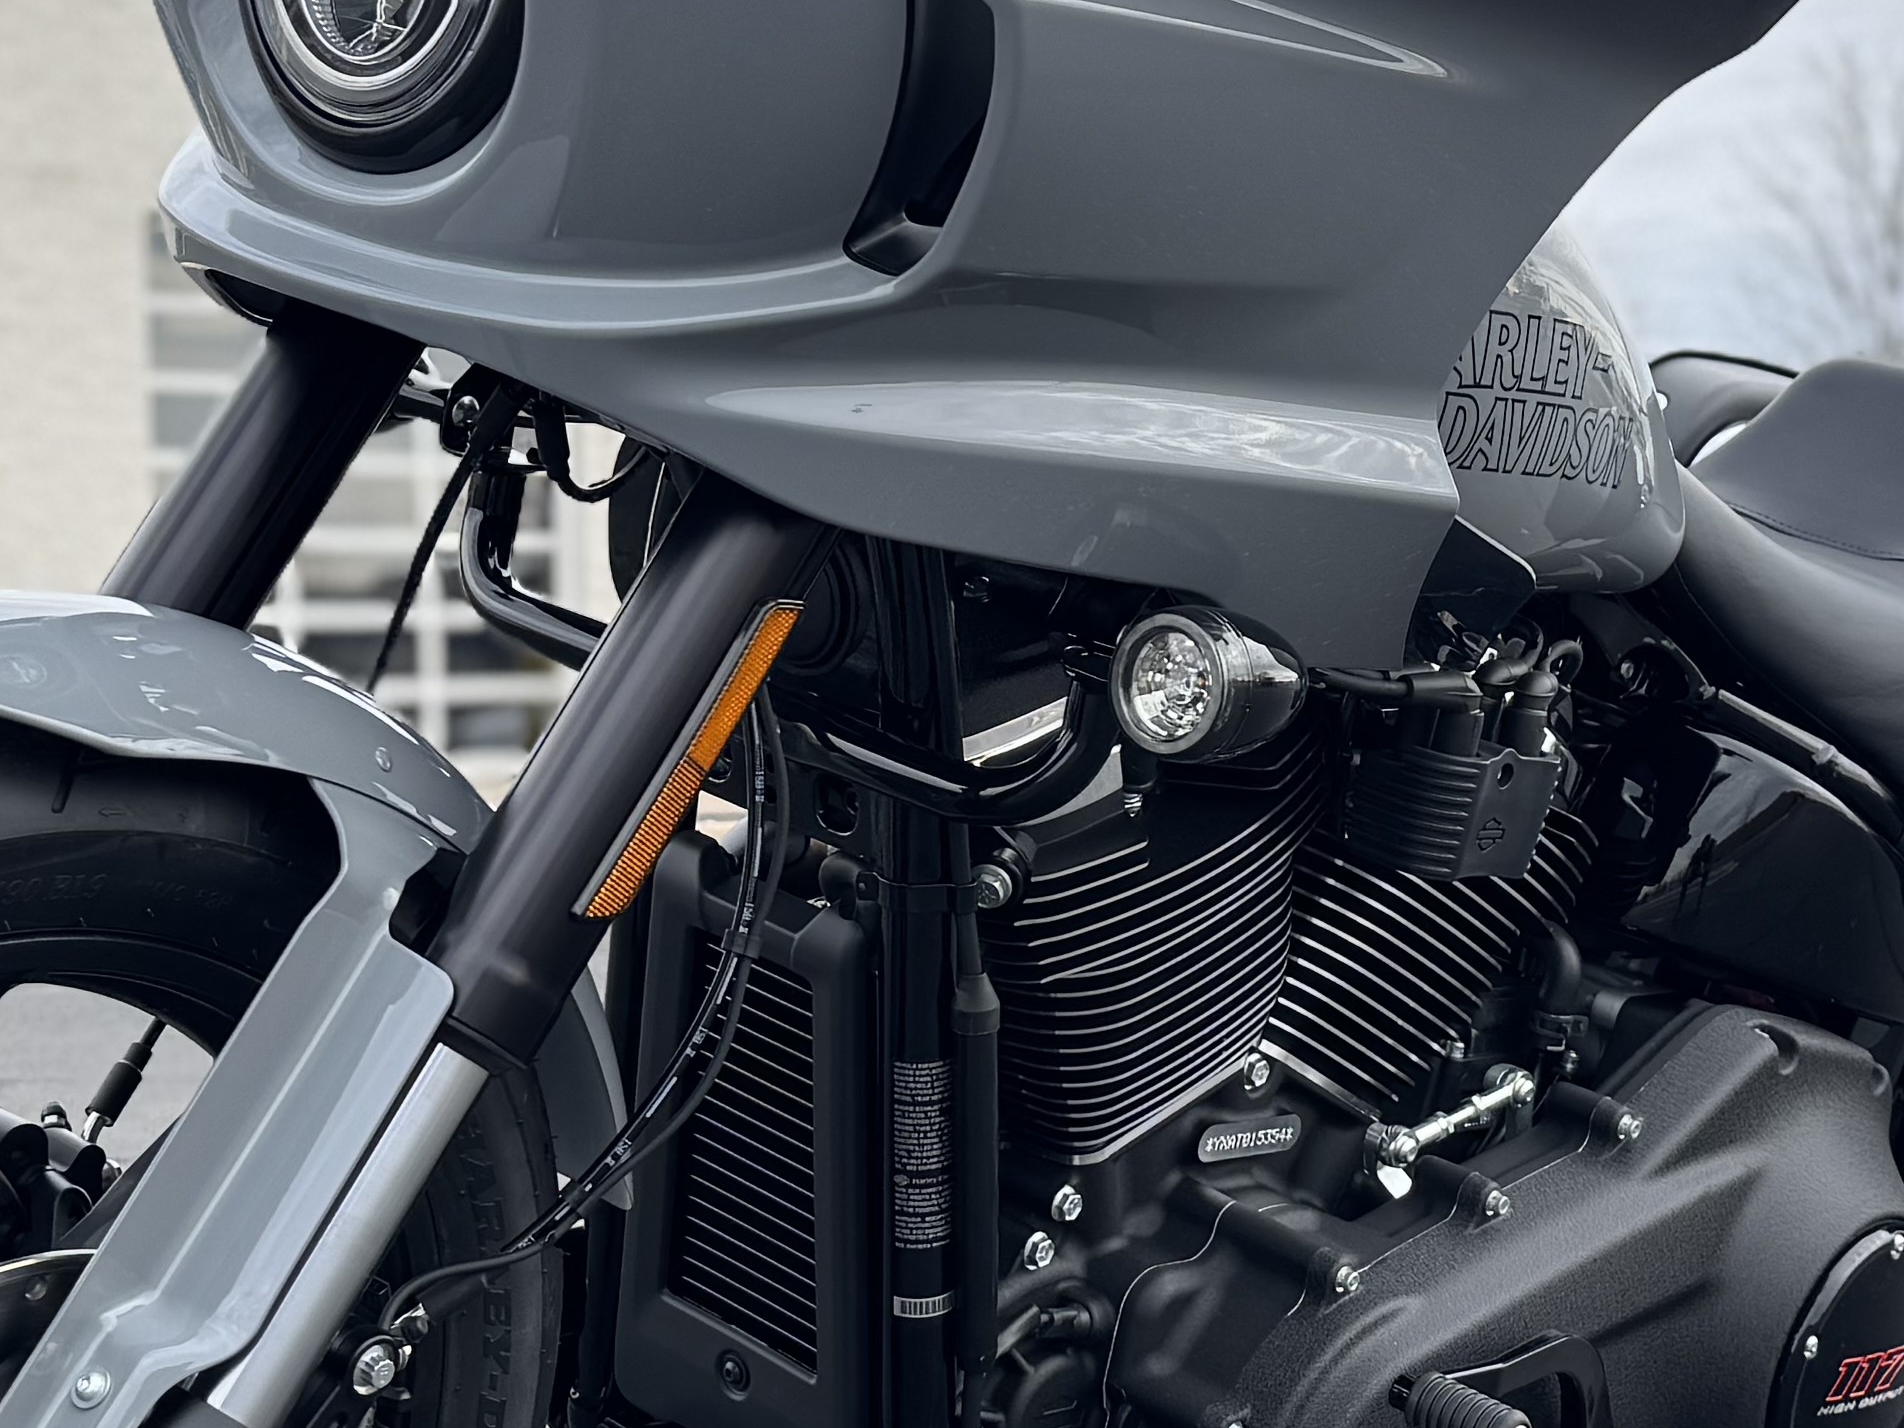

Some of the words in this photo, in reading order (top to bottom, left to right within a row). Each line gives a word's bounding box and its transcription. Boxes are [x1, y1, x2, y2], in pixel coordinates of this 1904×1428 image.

[1452, 309, 1613, 400] ARLEY-
[1436, 390, 1635, 488] DAVIDSON
[1817, 1400, 1857, 1416] HIGH
[1858, 1385, 1904, 1409] OUTPUT
